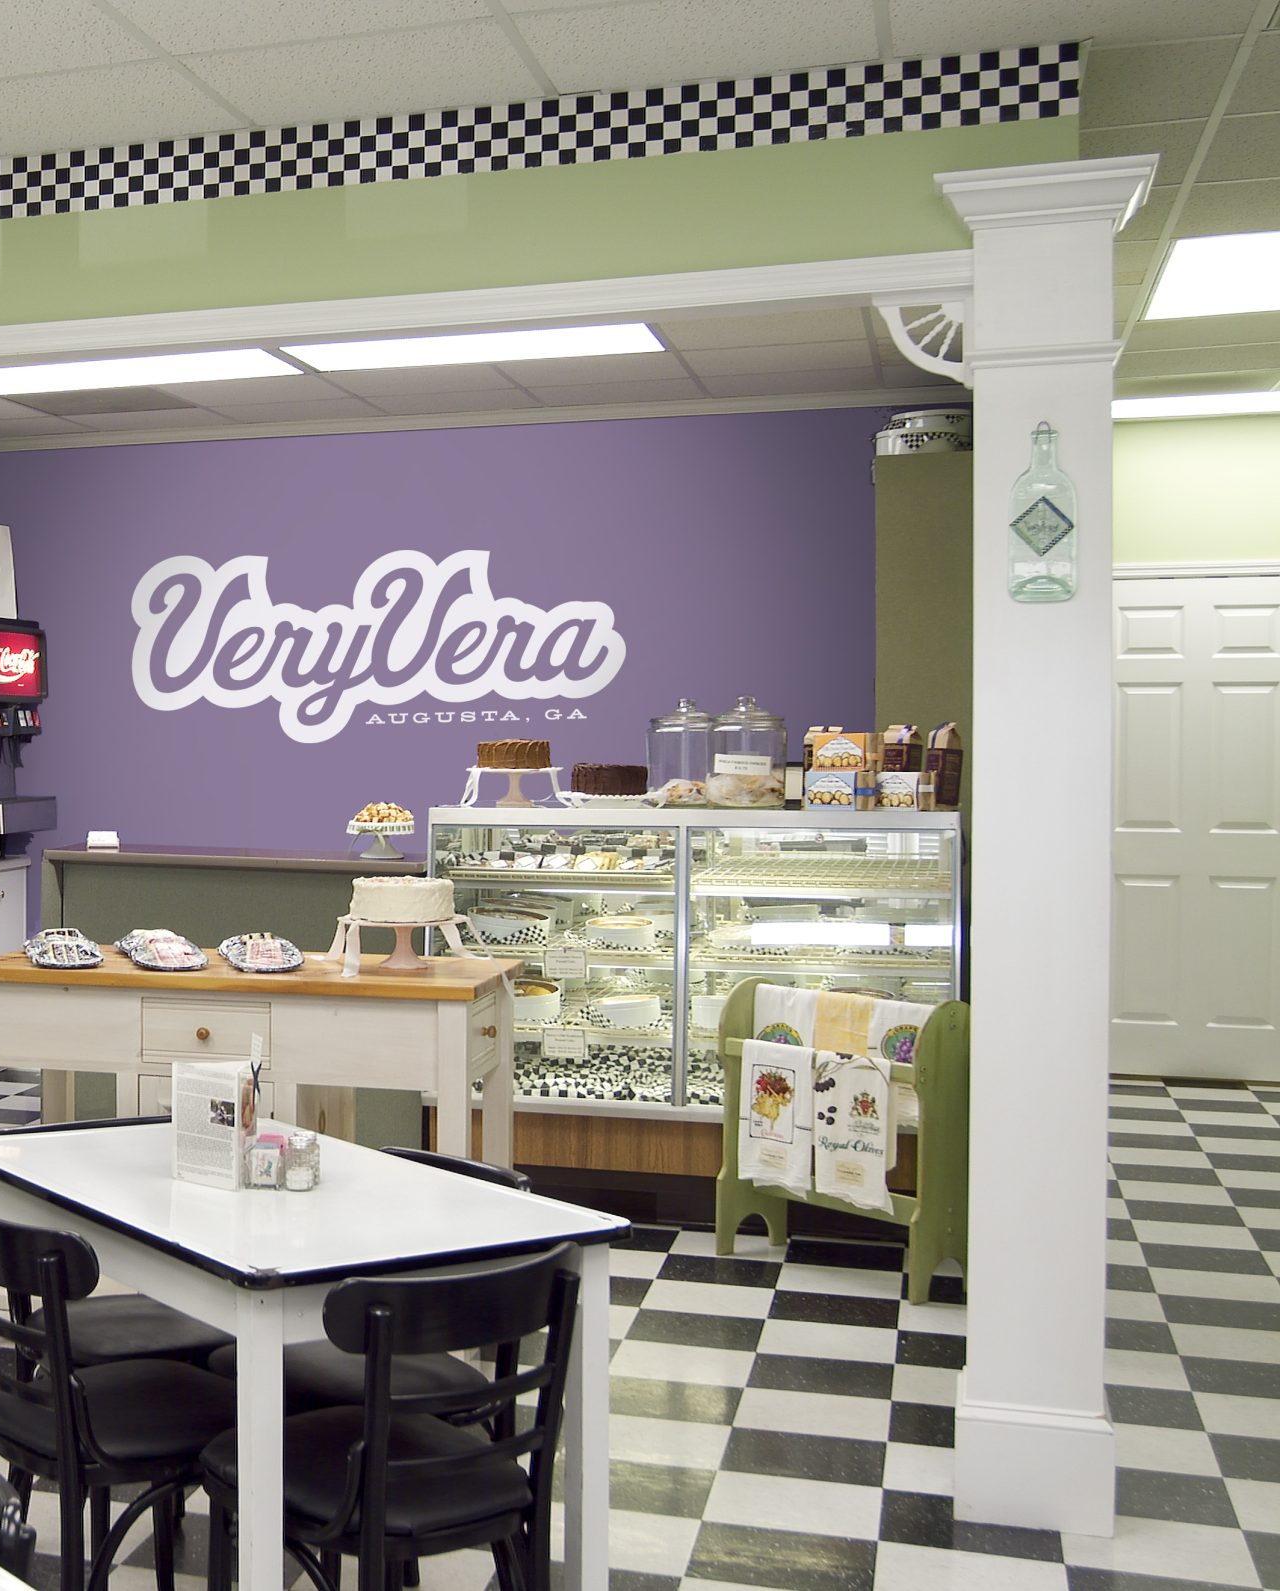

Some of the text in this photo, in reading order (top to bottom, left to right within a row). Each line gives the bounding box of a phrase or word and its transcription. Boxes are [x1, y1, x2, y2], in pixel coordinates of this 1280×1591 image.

[366, 708, 587, 725] AUGUSTA, GA
[818, 1136, 885, 1157] Royal Olives
